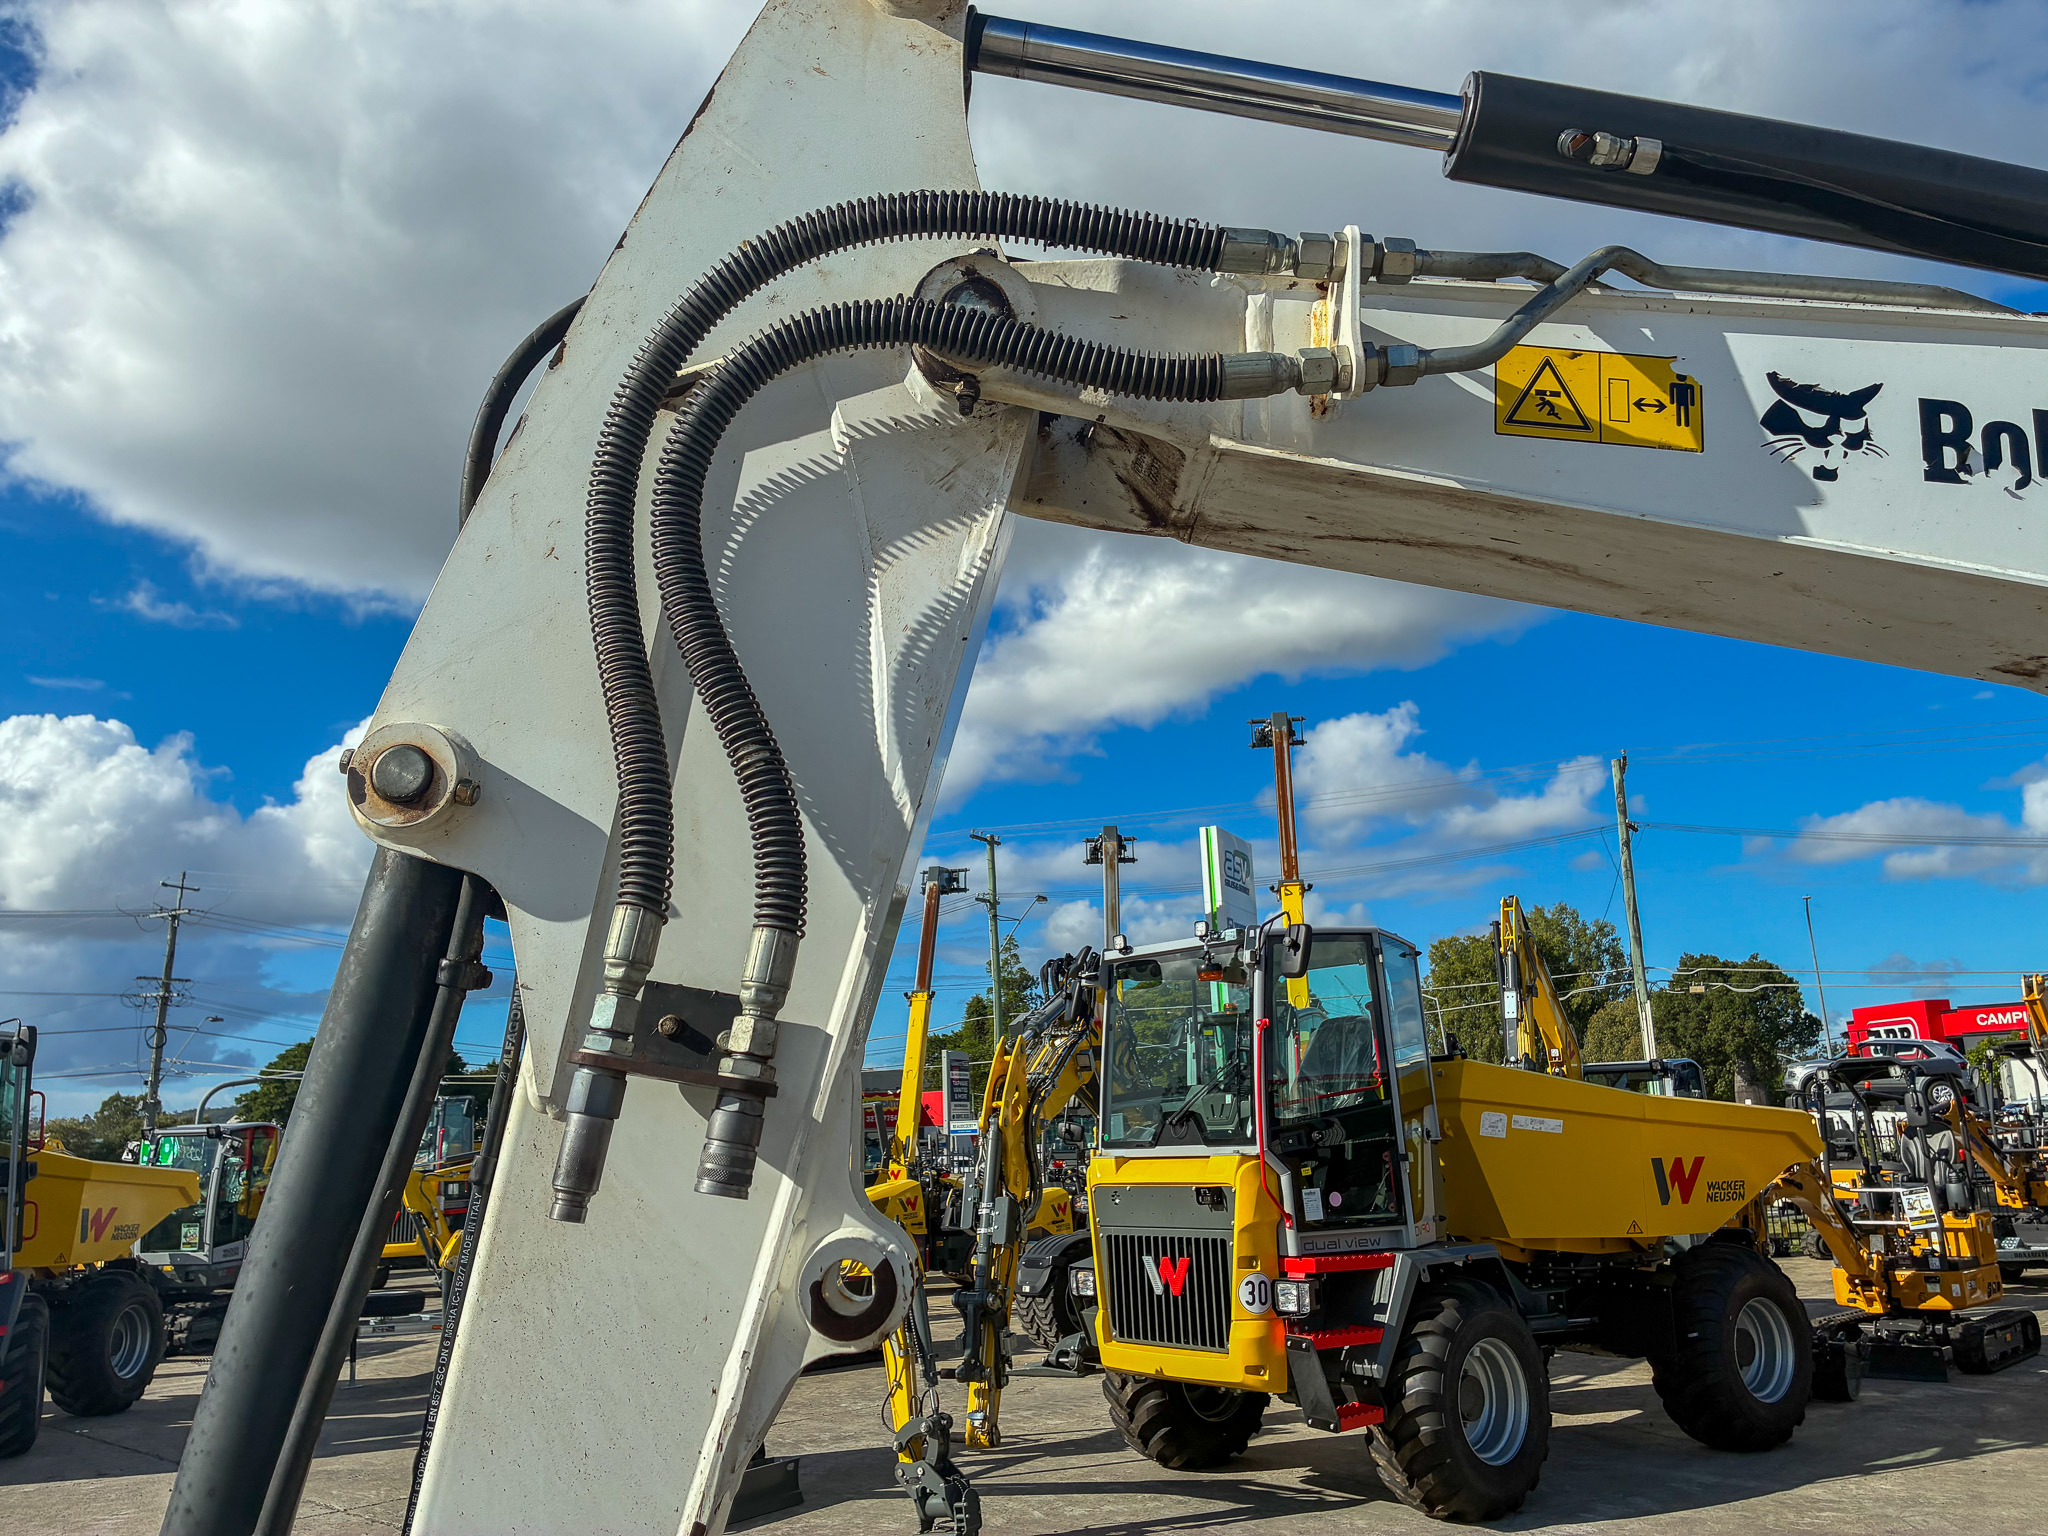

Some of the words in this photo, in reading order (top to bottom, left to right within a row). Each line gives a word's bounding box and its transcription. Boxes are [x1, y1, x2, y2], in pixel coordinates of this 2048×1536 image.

[1706, 1180, 1746, 1192] WACKER
[1706, 1190, 1746, 1203] NEUSON
[471, 1192, 482, 1220] ITALY
[114, 1223, 141, 1234] WACKER
[467, 1221, 476, 1232] IN
[460, 1234, 474, 1264] MADE
[1303, 1238, 1341, 1251] dual
[1344, 1236, 1382, 1248] view
[1244, 1280, 1268, 1307] 30
[444, 1308, 457, 1338] MSHA
[439, 1348, 449, 1364] DN
[435, 1366, 446, 1386] 2SC
[431, 1388, 441, 1406] 857
[428, 1408, 438, 1422] EN
